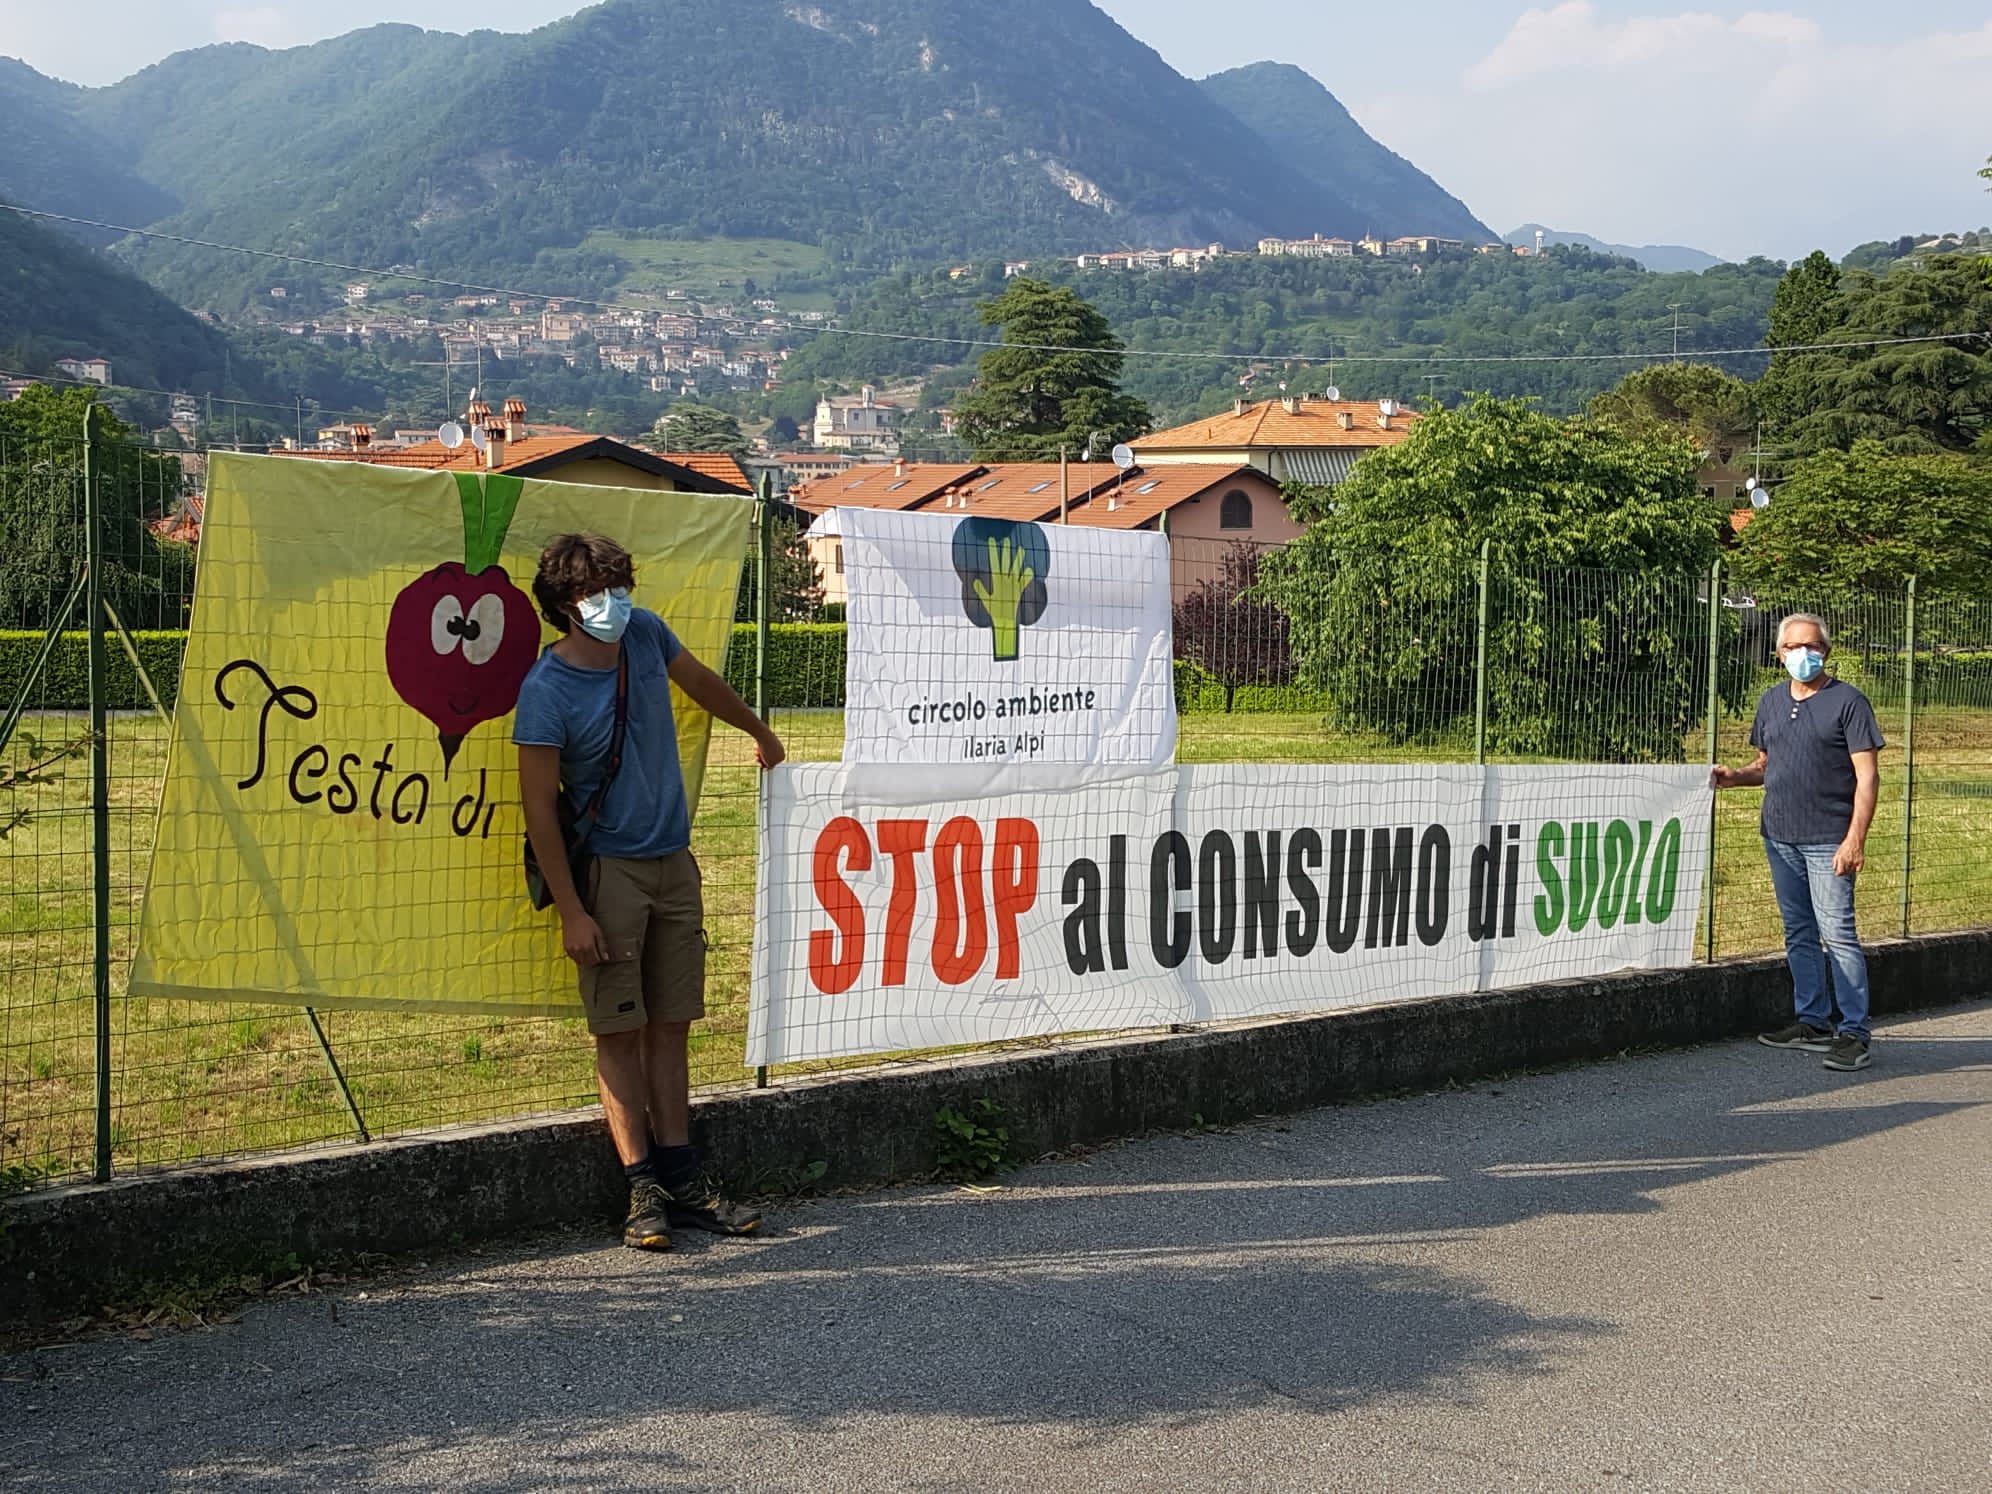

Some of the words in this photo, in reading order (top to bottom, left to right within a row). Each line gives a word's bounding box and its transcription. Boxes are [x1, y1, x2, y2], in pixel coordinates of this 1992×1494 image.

[214, 659, 430, 825] Testa
[452, 767, 496, 839] di
[908, 691, 986, 726] circolo
[995, 686, 1096, 718] ambiente
[964, 735, 1007, 759] Ilaria
[1014, 730, 1045, 758] Alpi
[809, 815, 1040, 995] STOP
[1061, 834, 1129, 976] al
[1149, 823, 1451, 968] CONSUMO
[1467, 823, 1521, 942] di
[1533, 816, 1682, 937] SUOLO
